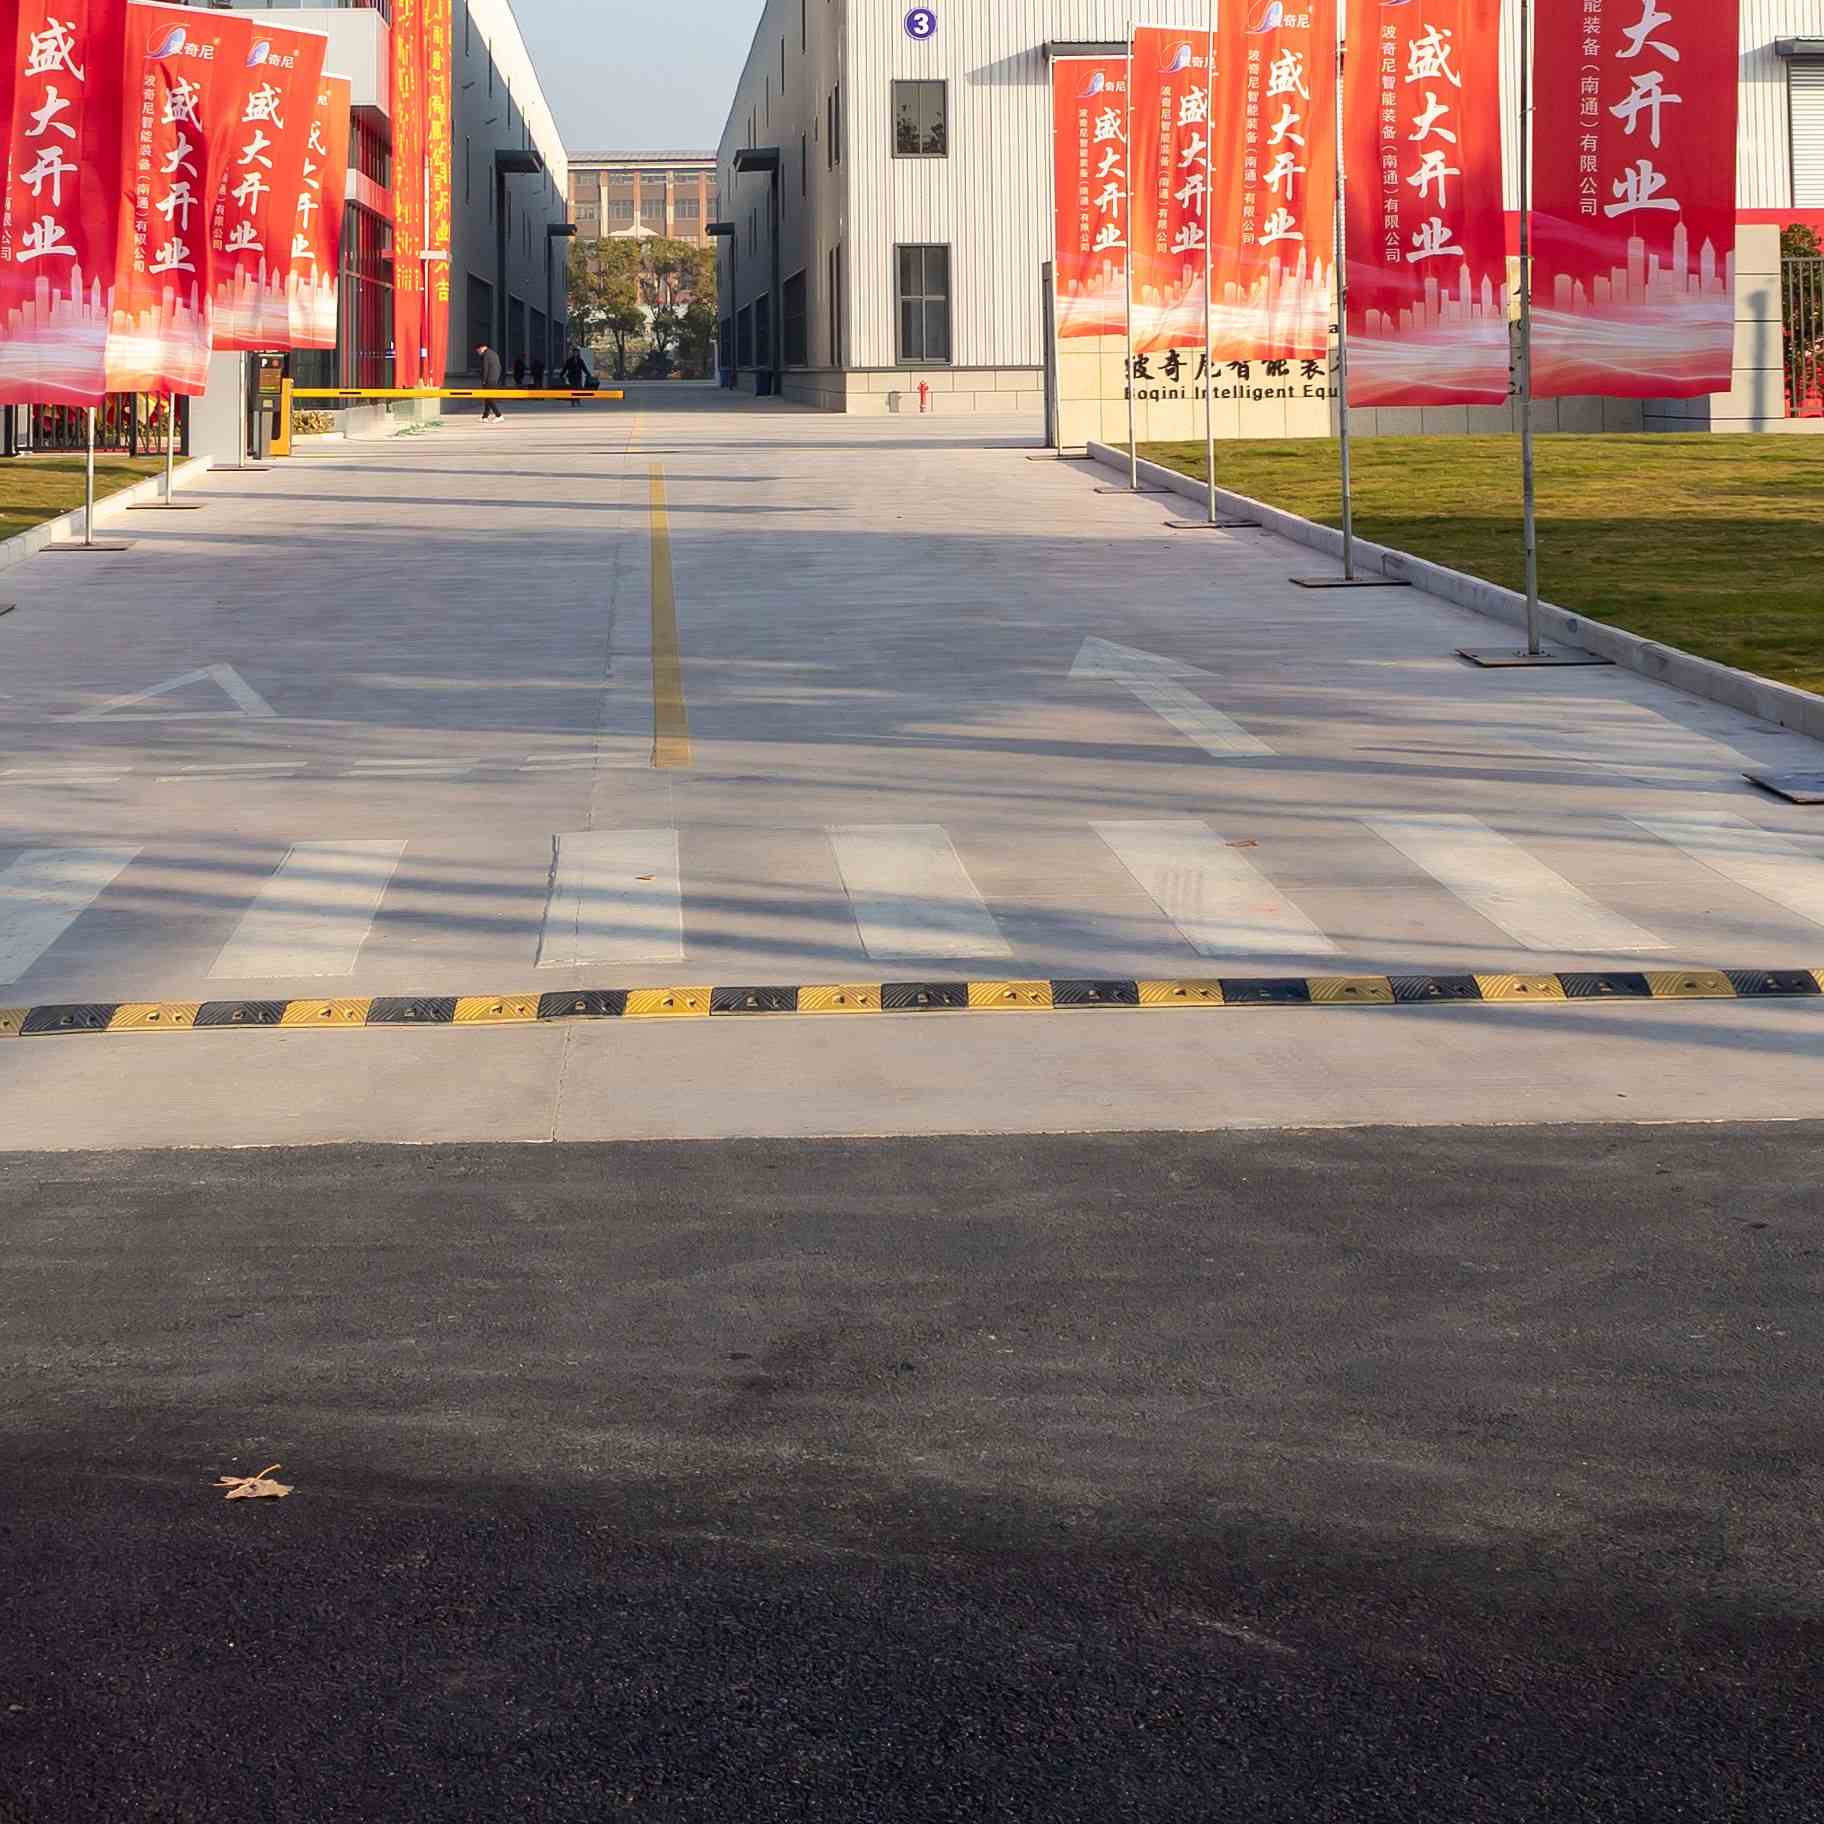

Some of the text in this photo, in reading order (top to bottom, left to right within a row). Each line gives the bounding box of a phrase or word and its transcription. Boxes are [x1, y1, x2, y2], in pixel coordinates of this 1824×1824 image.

[912, 12, 930, 35] 3
[15, 16, 86, 263] 盛大开业
[1258, 47, 1309, 248] 盛大开业
[1404, 22, 1463, 264] 盛大开业
